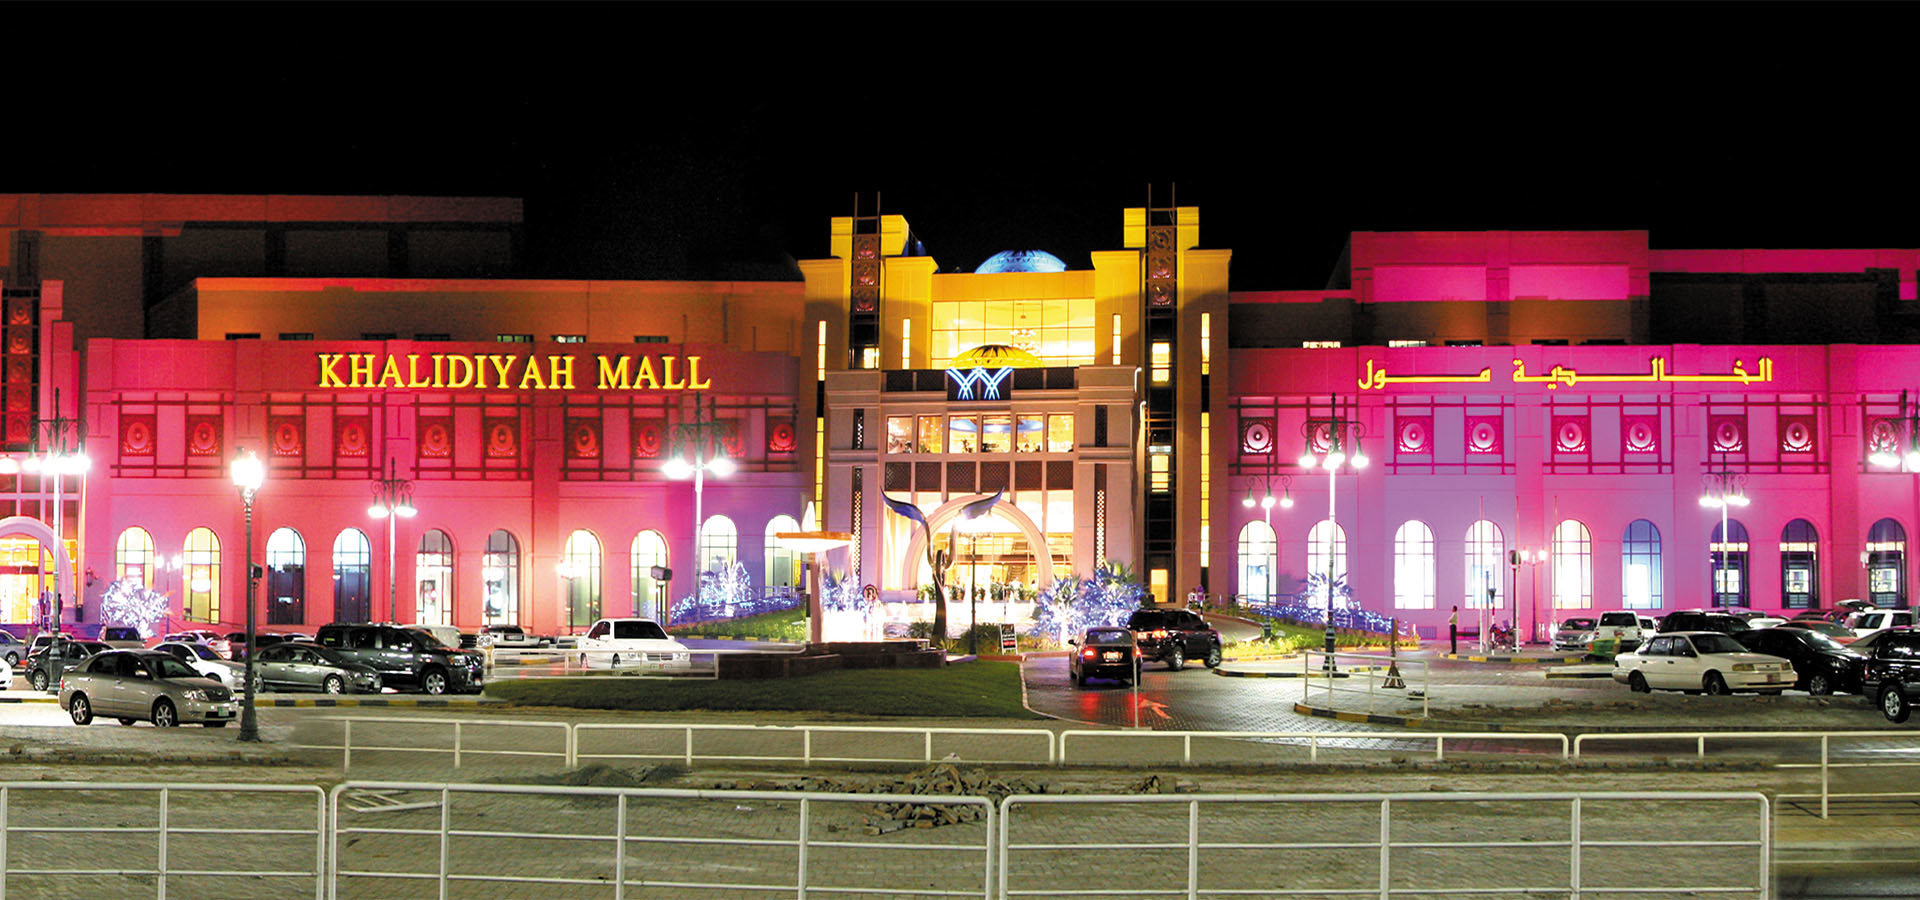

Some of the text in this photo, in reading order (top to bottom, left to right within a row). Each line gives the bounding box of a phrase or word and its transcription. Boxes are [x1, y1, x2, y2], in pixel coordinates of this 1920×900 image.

[318, 353, 712, 390] KHALIDIYAH MALL
[1357, 357, 1773, 391] الخالدية مول
